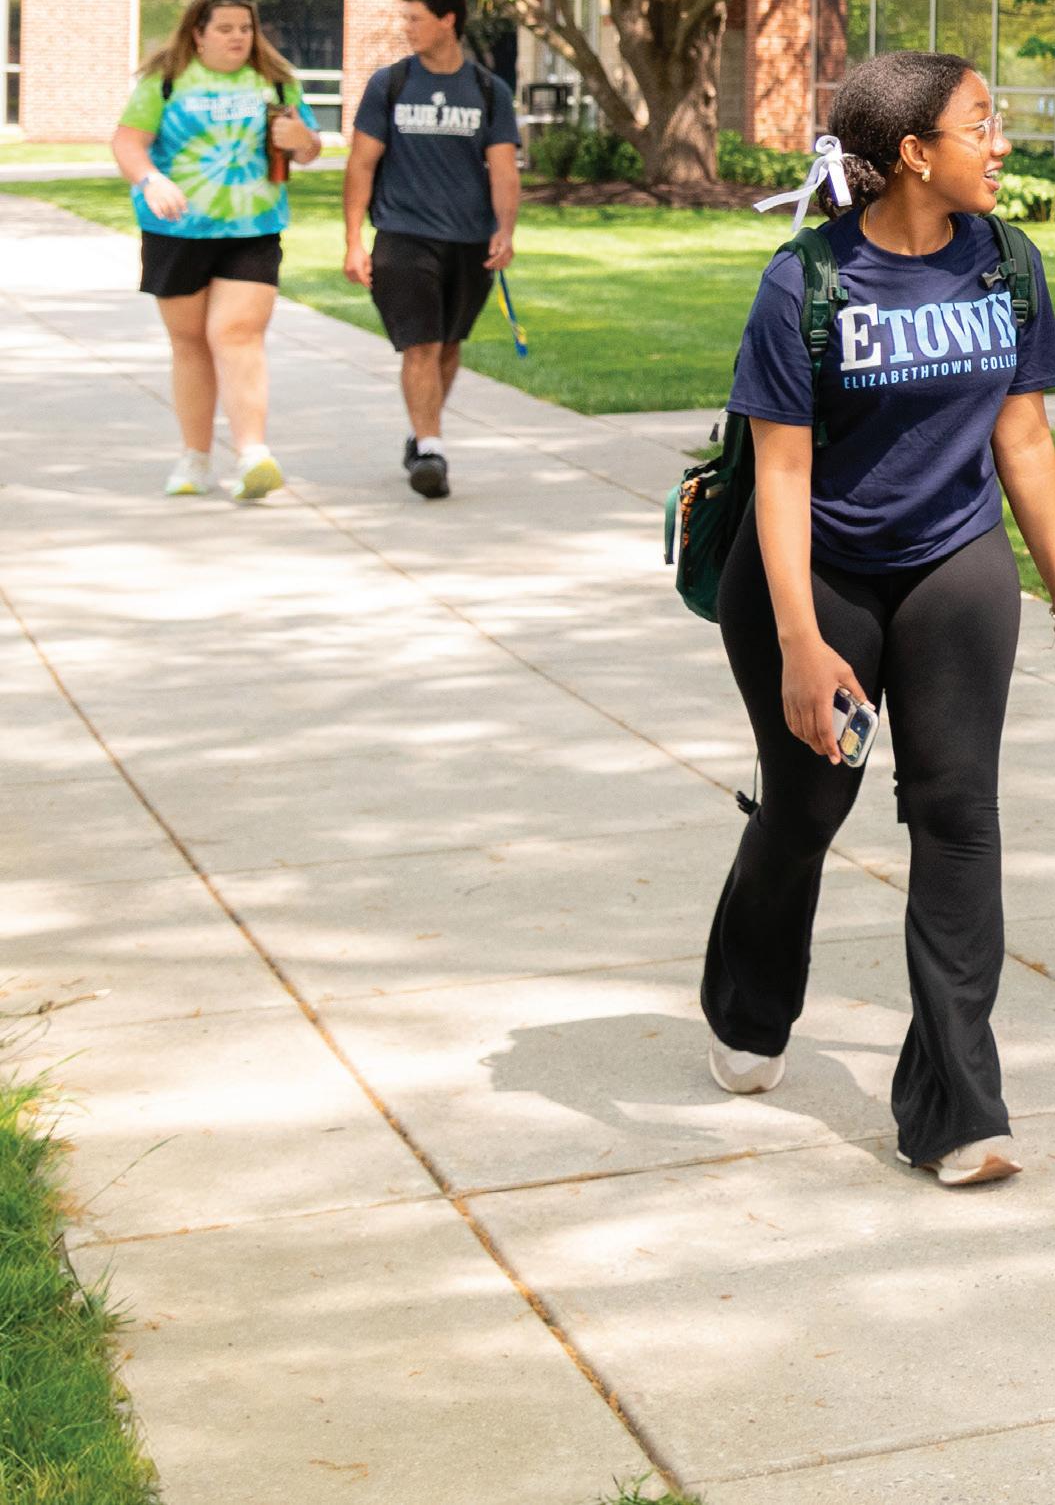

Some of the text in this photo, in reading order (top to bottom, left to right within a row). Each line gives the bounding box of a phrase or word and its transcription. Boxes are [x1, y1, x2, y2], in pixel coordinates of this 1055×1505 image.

[394, 103, 482, 130] BLUE JAYS
[837, 291, 1017, 372] ETOWN
[843, 358, 973, 390] ELIZABETHTOWN
